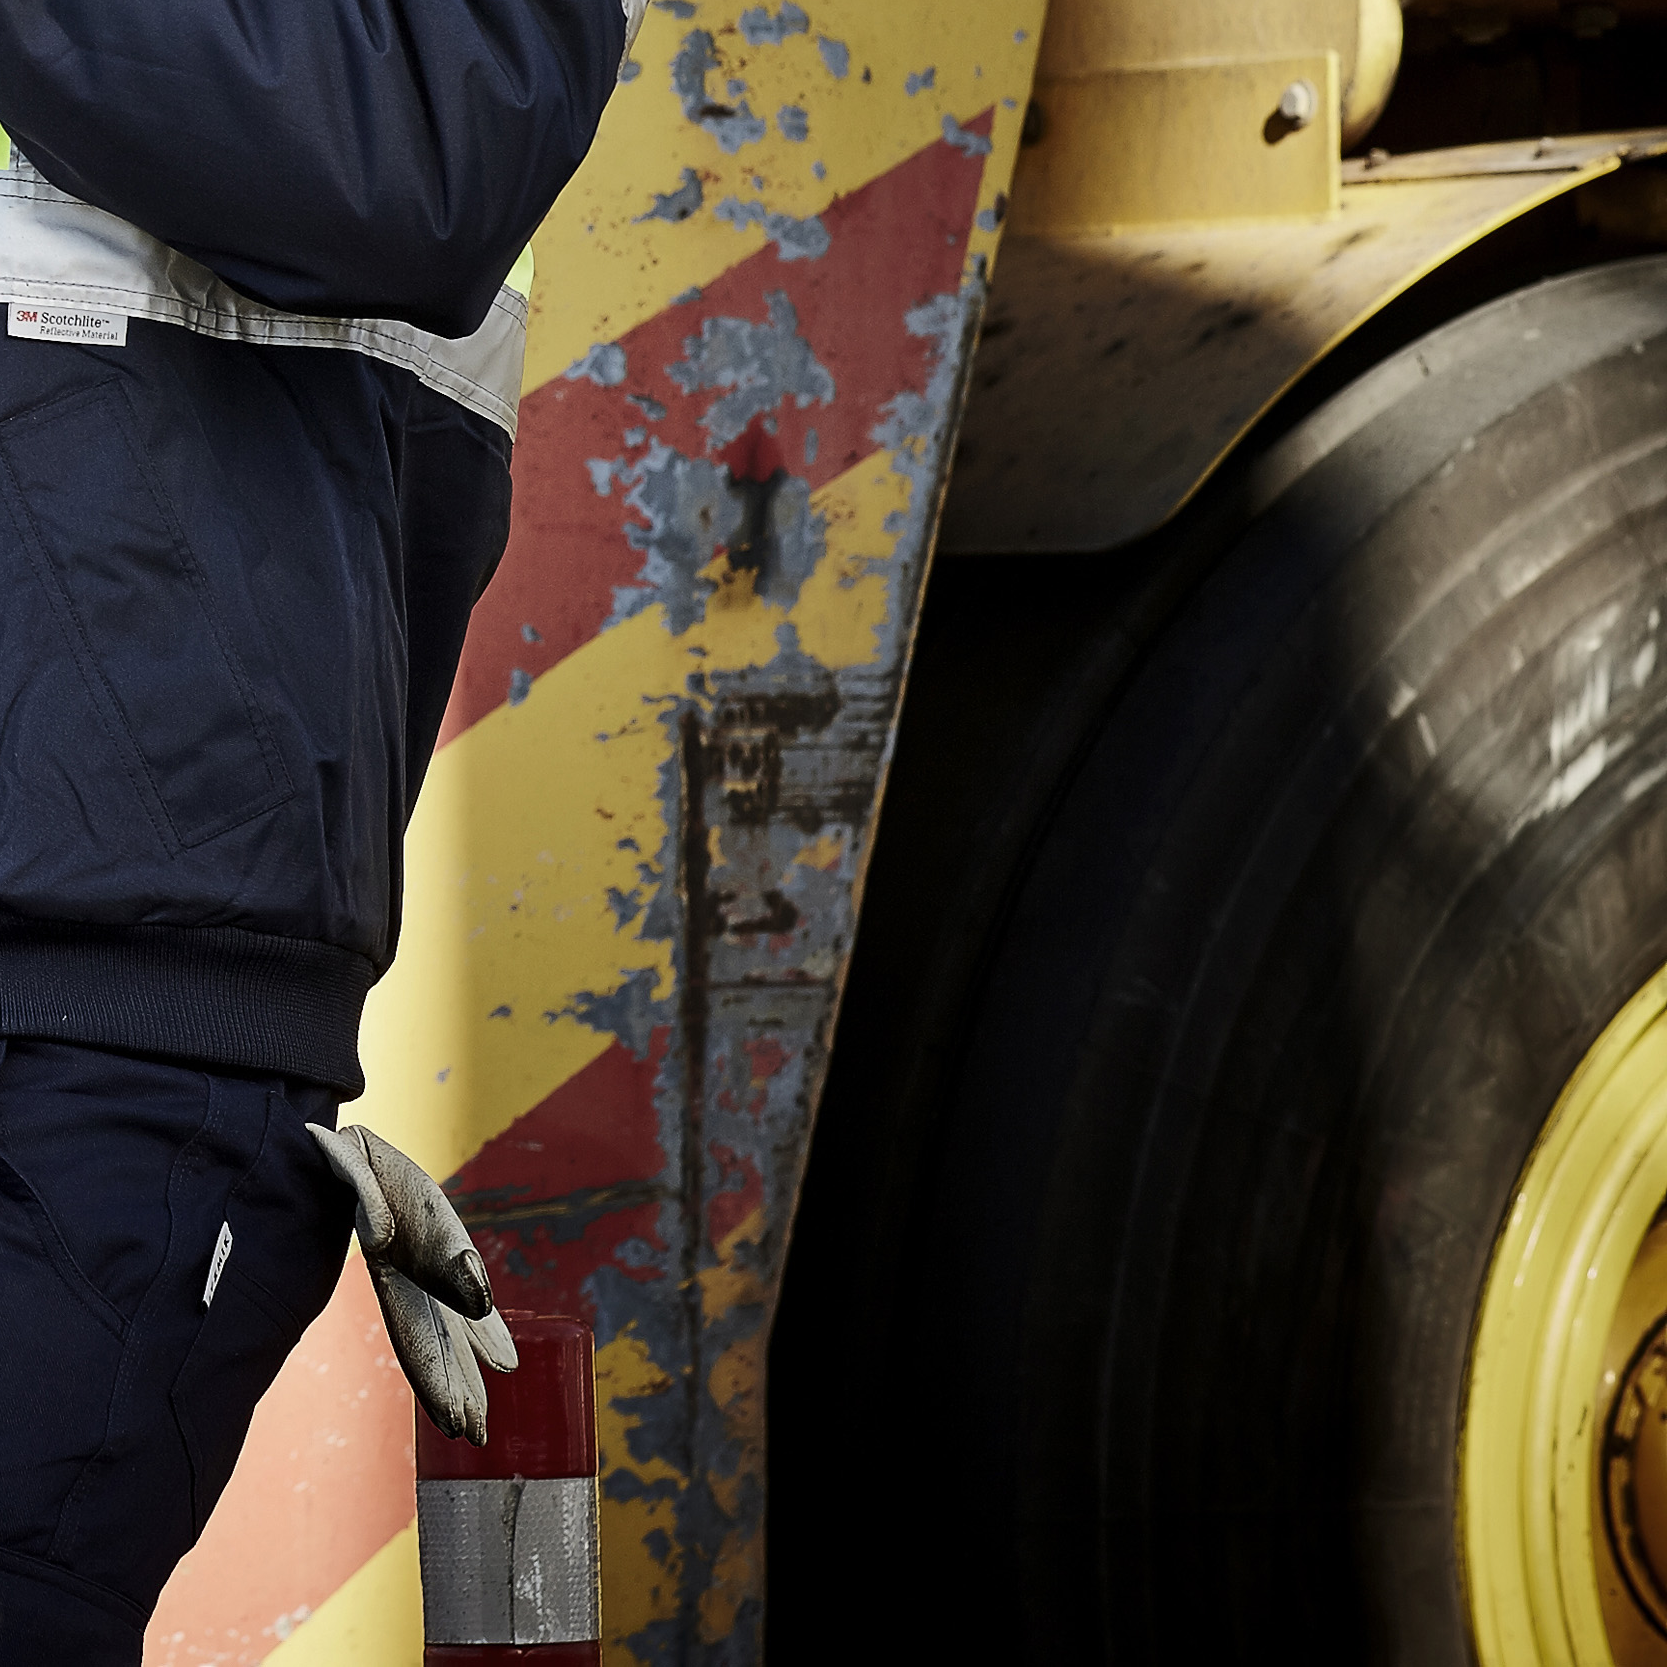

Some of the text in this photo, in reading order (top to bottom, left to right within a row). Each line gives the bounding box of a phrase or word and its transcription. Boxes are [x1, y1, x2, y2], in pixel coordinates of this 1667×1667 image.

[15, 310, 38, 323] 3M
[40, 325, 118, 341] Reflective Material
